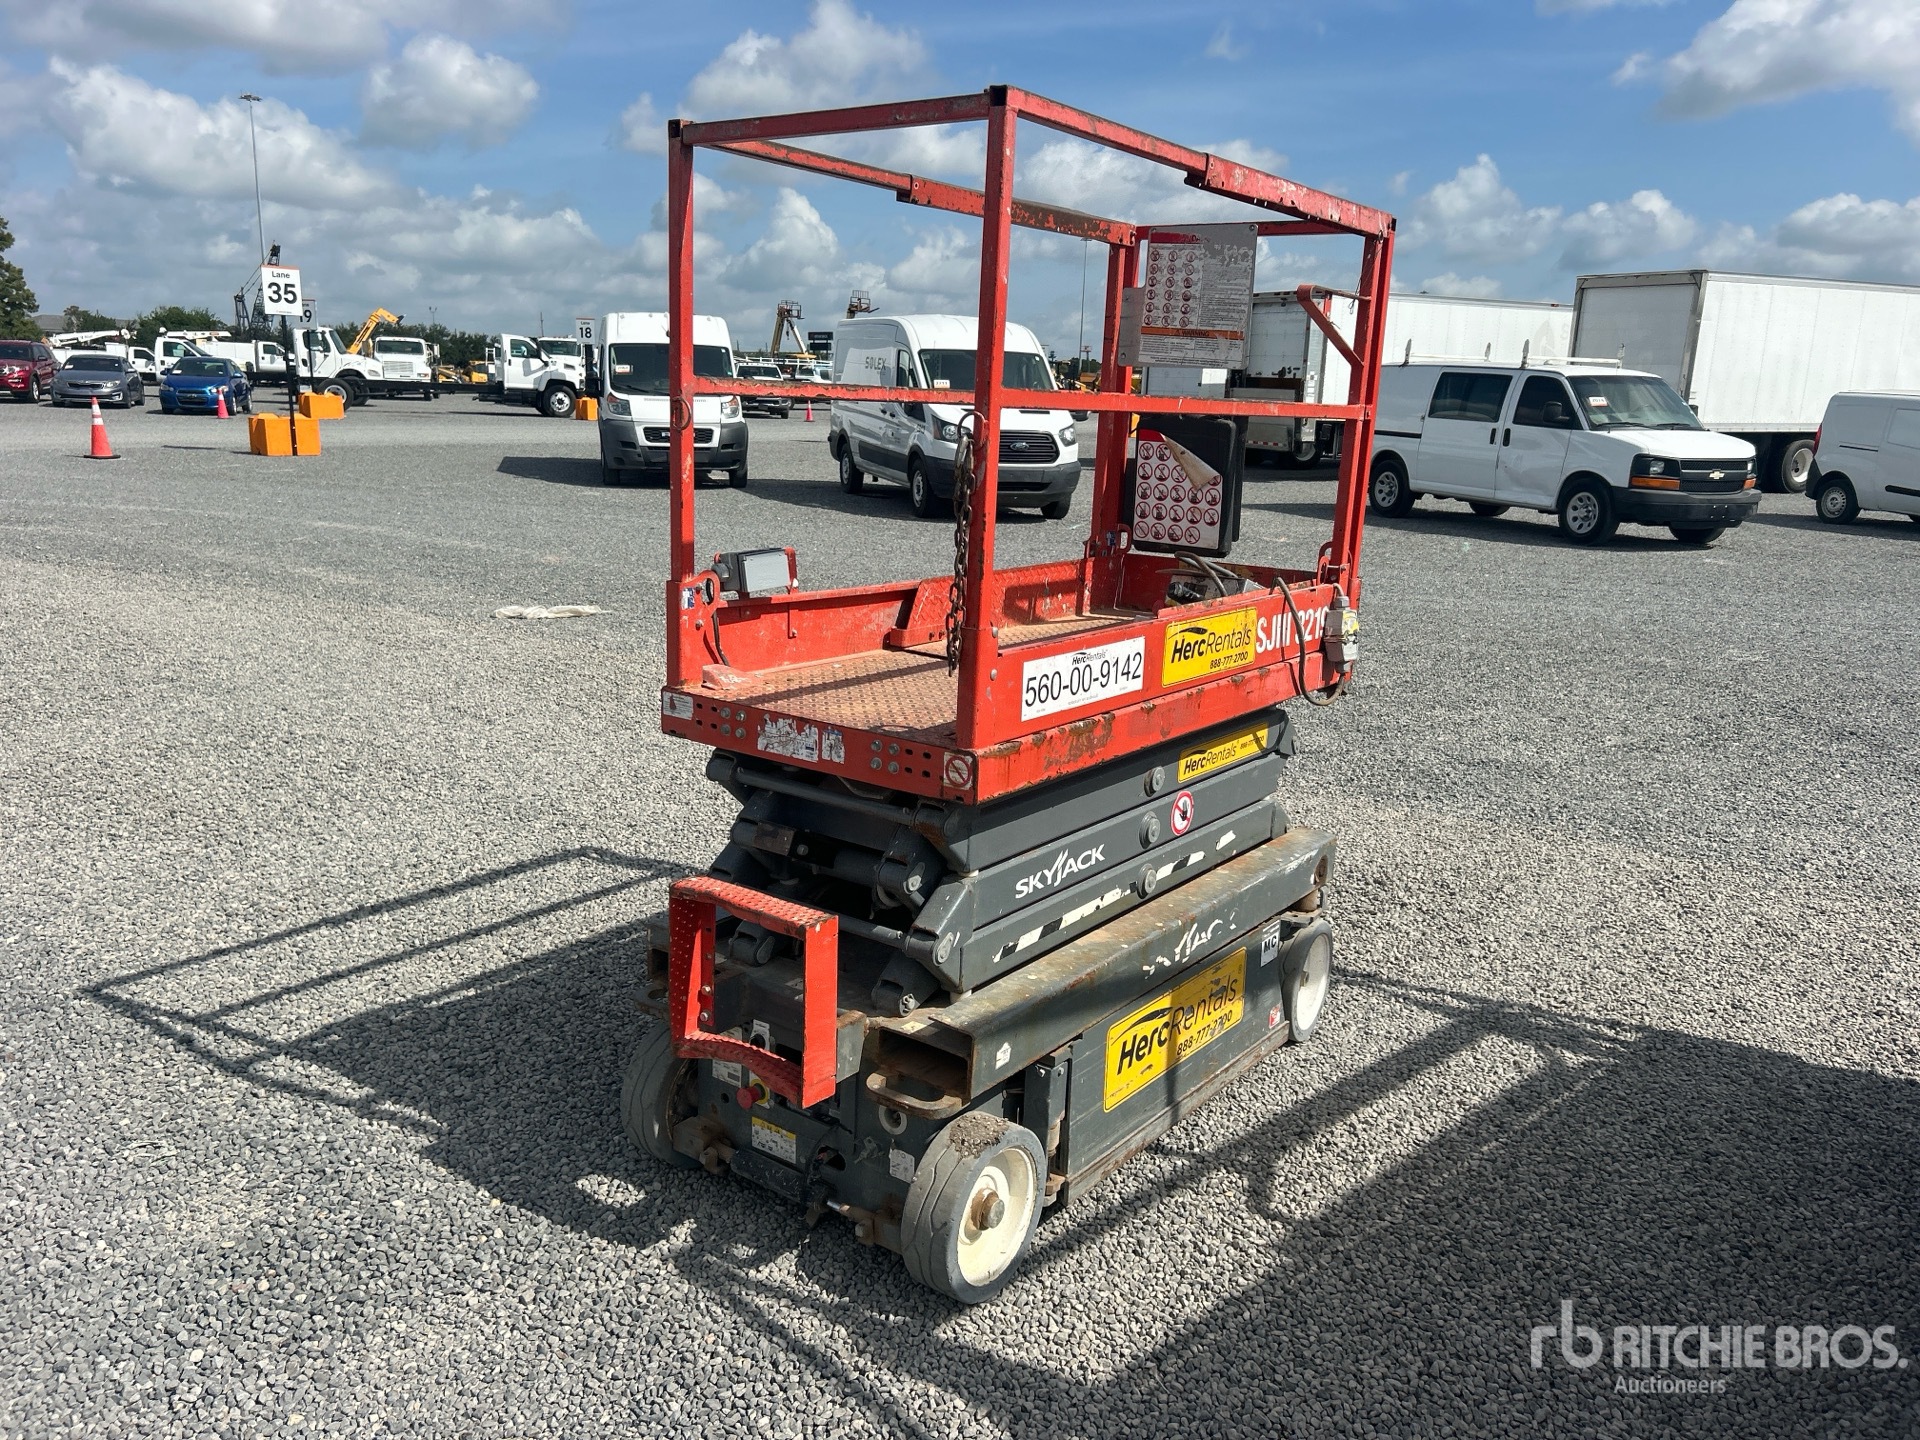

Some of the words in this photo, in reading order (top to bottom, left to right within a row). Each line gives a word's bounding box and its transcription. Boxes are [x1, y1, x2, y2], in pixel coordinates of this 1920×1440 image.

[267, 282, 297, 304] 35
[579, 327, 591, 338] 18
[865, 356, 886, 370] SOLEX
[1170, 623, 1252, 664] HercRentals
[1072, 650, 1107, 666] HercRentals
[1209, 651, 1249, 670] 888-777-2700
[1025, 651, 1143, 708] 560-00-9142
[1183, 743, 1237, 776] HercRentals
[1015, 843, 1106, 899] SKYJACK
[1263, 935, 1277, 954] MC
[1116, 975, 1238, 1076] HercRentals
